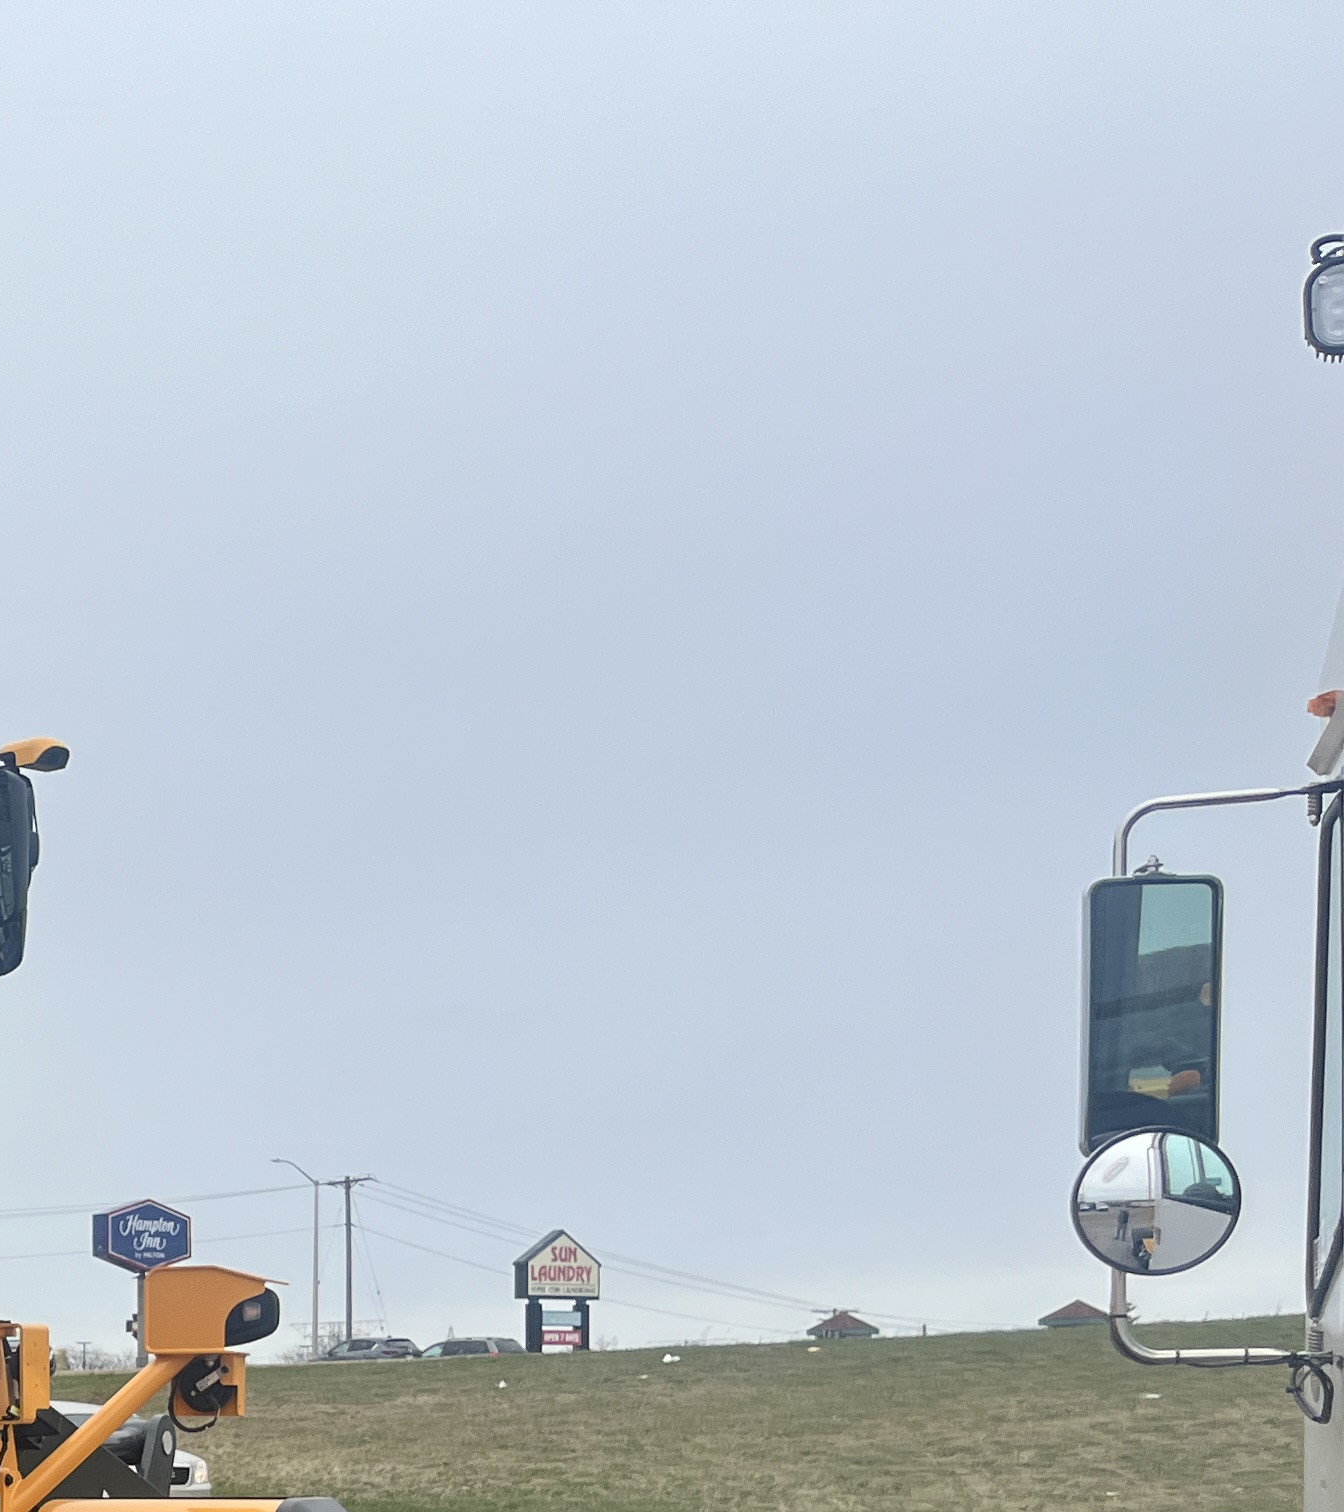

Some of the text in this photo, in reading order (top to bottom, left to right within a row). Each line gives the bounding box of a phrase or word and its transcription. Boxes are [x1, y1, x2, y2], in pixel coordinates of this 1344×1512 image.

[119, 1213, 180, 1237] Hampton
[133, 1232, 166, 1251] Inn
[551, 1245, 578, 1263] SUN
[530, 1264, 592, 1284] LAUNDRY
